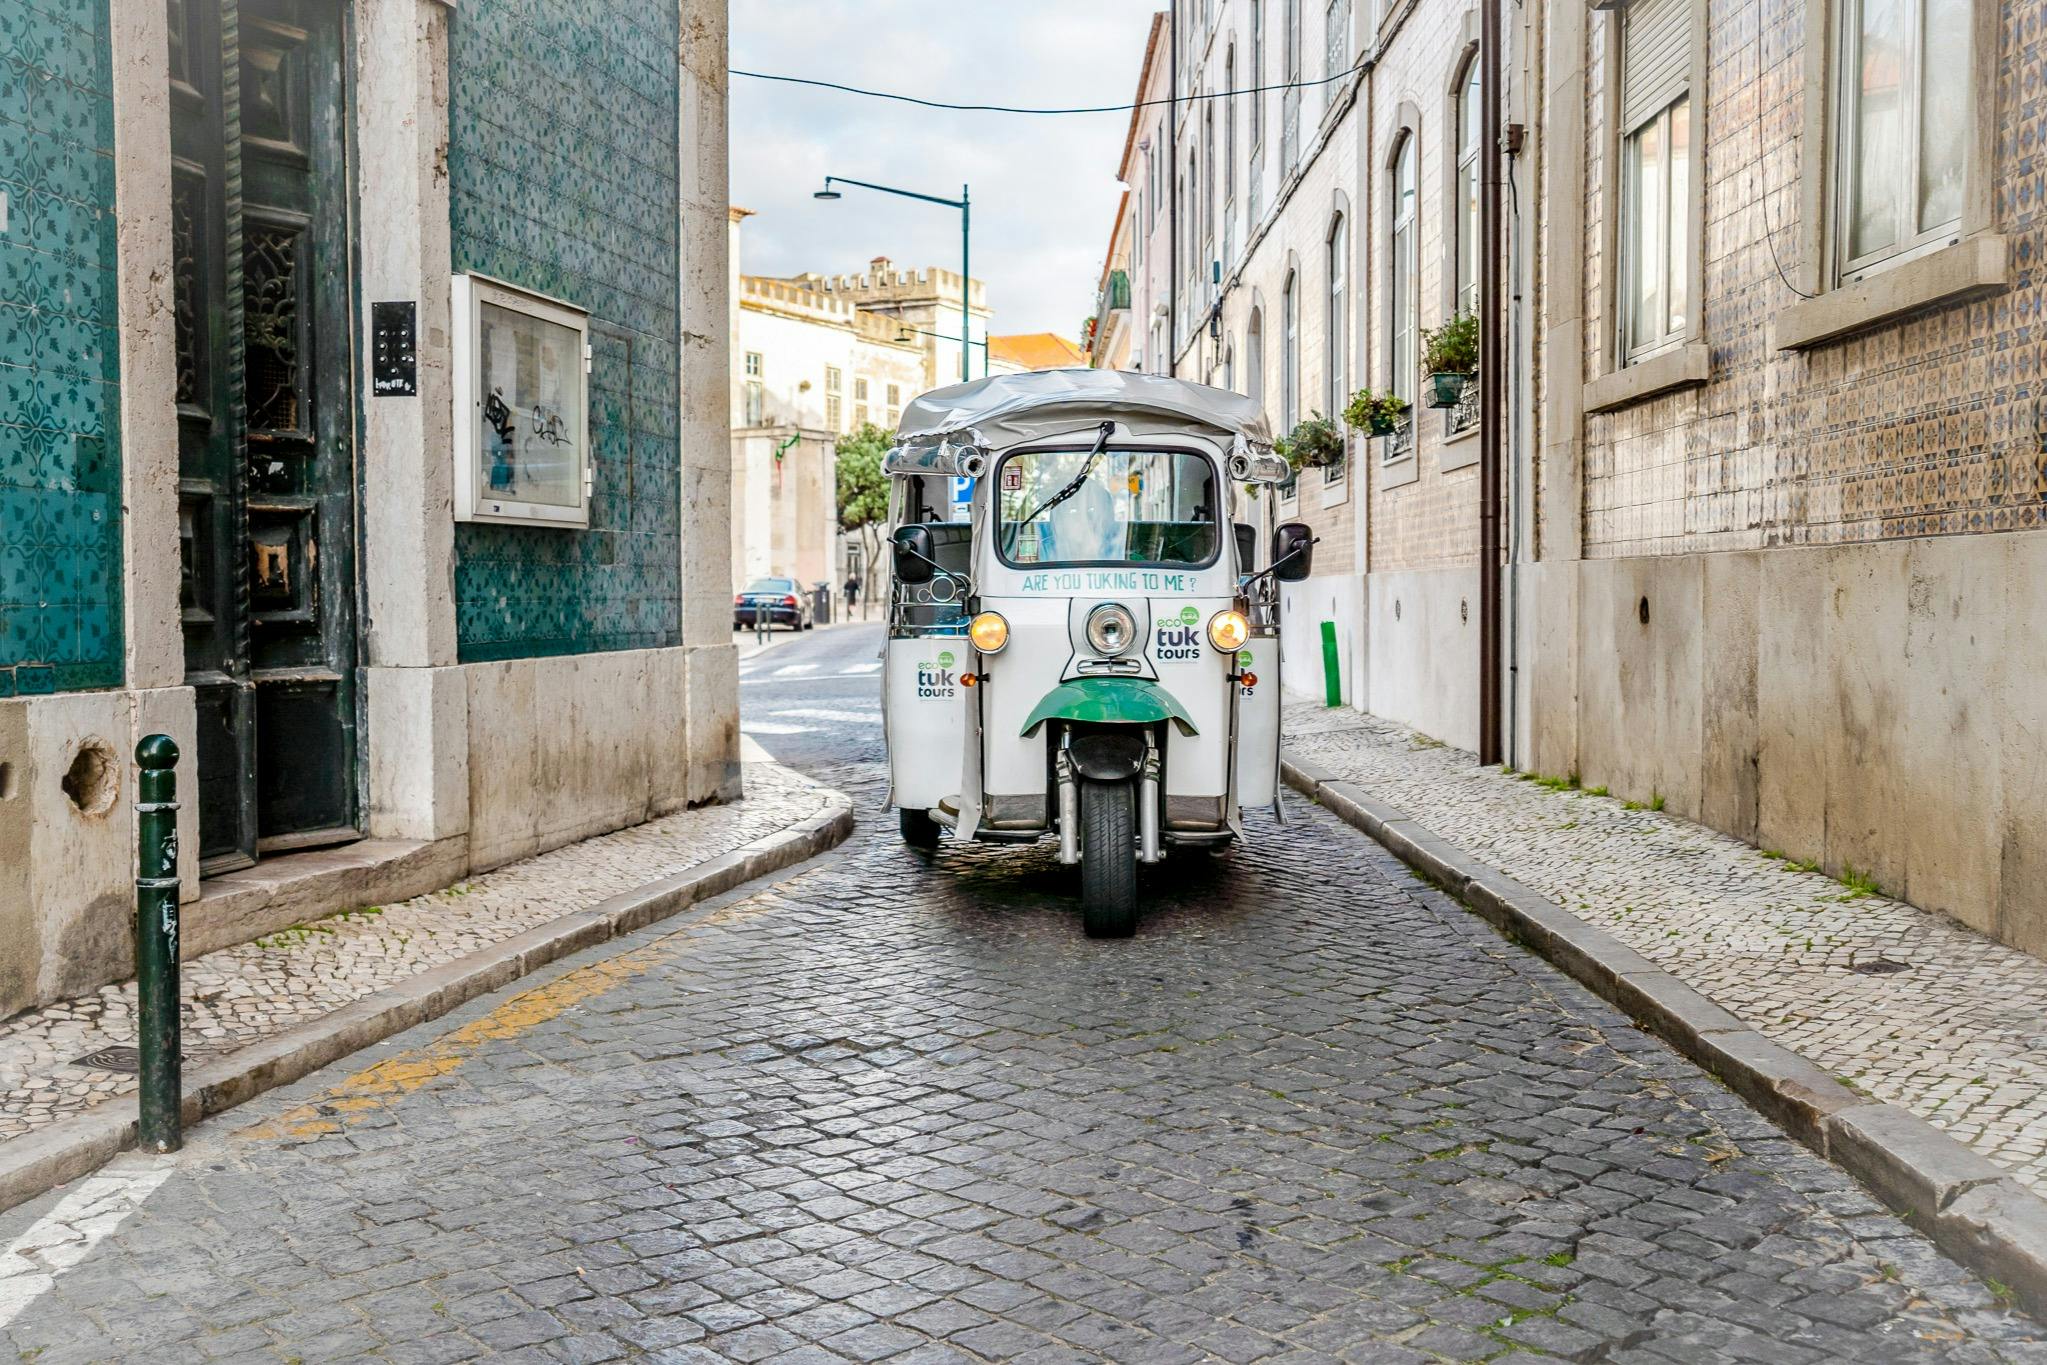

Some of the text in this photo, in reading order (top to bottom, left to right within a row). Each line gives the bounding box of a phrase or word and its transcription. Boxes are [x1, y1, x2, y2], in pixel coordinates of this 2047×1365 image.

[953, 476, 971, 502] P
[1022, 572, 1198, 592] ARE YOU TUKING TO ME ?
[1157, 619, 1181, 628] eco
[1157, 626, 1200, 647] tuk
[1157, 648, 1200, 660] tours
[918, 662, 938, 670] eco
[918, 669, 954, 687] tuk
[918, 687, 954, 698] tours
